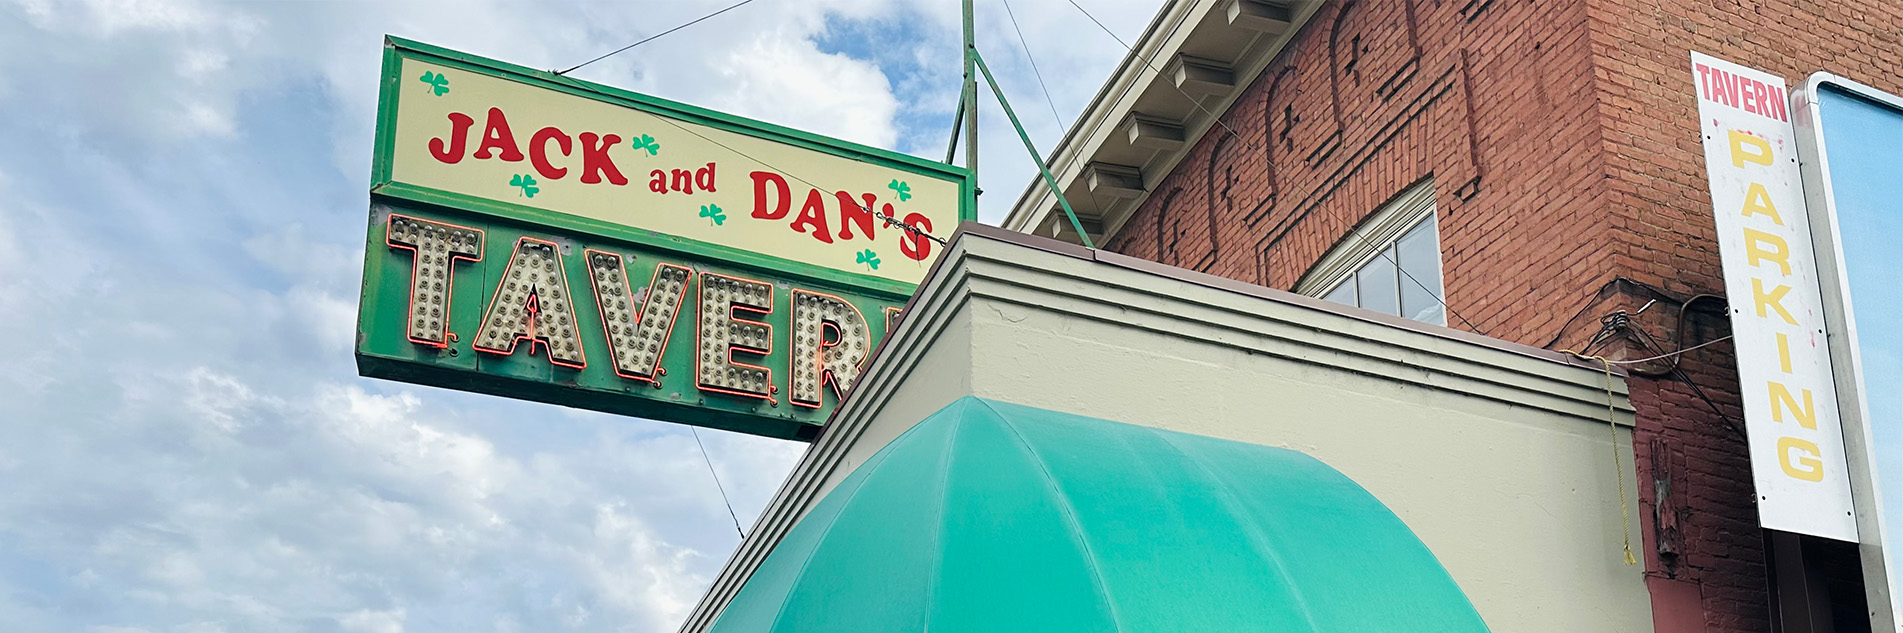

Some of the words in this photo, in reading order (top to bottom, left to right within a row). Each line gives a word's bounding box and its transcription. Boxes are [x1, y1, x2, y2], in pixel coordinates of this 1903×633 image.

[1695, 62, 1788, 123] TAVERN
[428, 106, 628, 186] JACK
[648, 162, 717, 195] and
[749, 170, 933, 261] DAN'S
[386, 213, 904, 409] TAVER
[1727, 129, 1824, 482] PARKING
